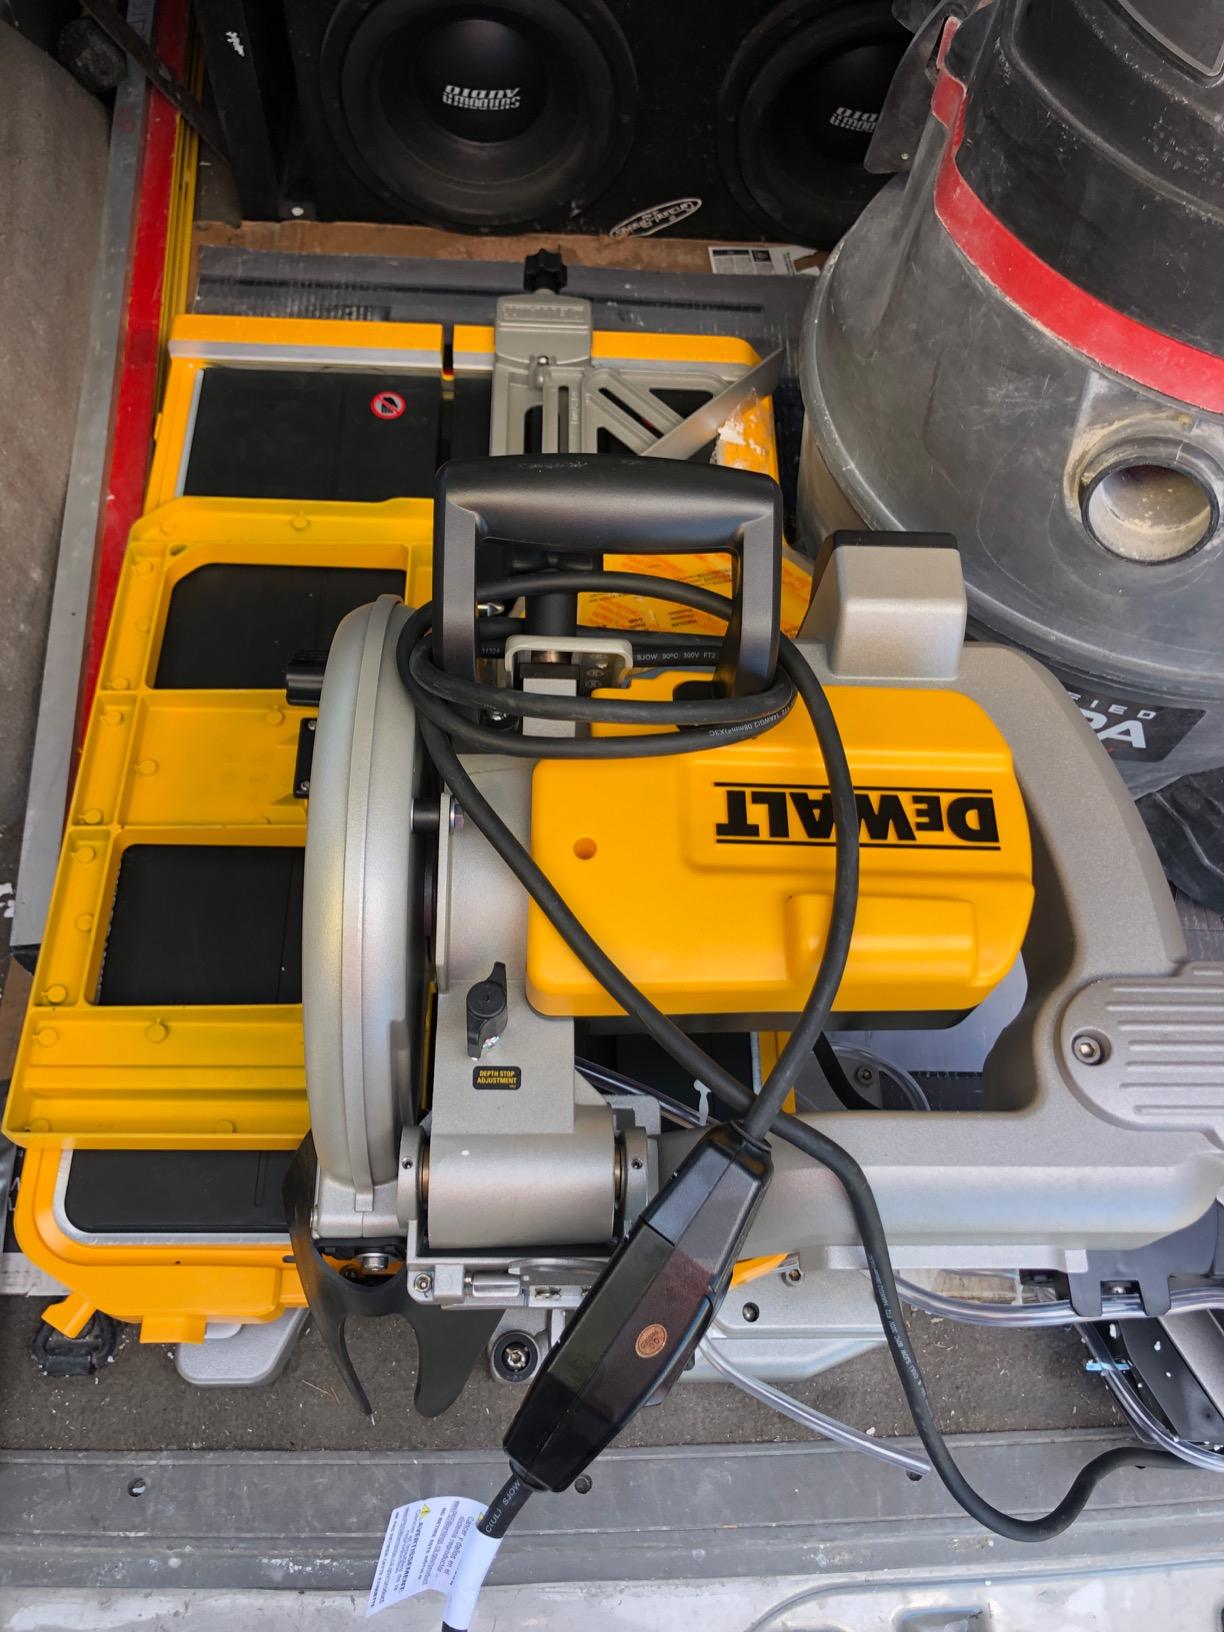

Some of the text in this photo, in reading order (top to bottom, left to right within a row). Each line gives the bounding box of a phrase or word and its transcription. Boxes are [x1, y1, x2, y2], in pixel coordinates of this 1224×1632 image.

[444, 84, 519, 98] AUDIO
[703, 651, 716, 659] FT2
[502, 1479, 520, 1505] SJOW
